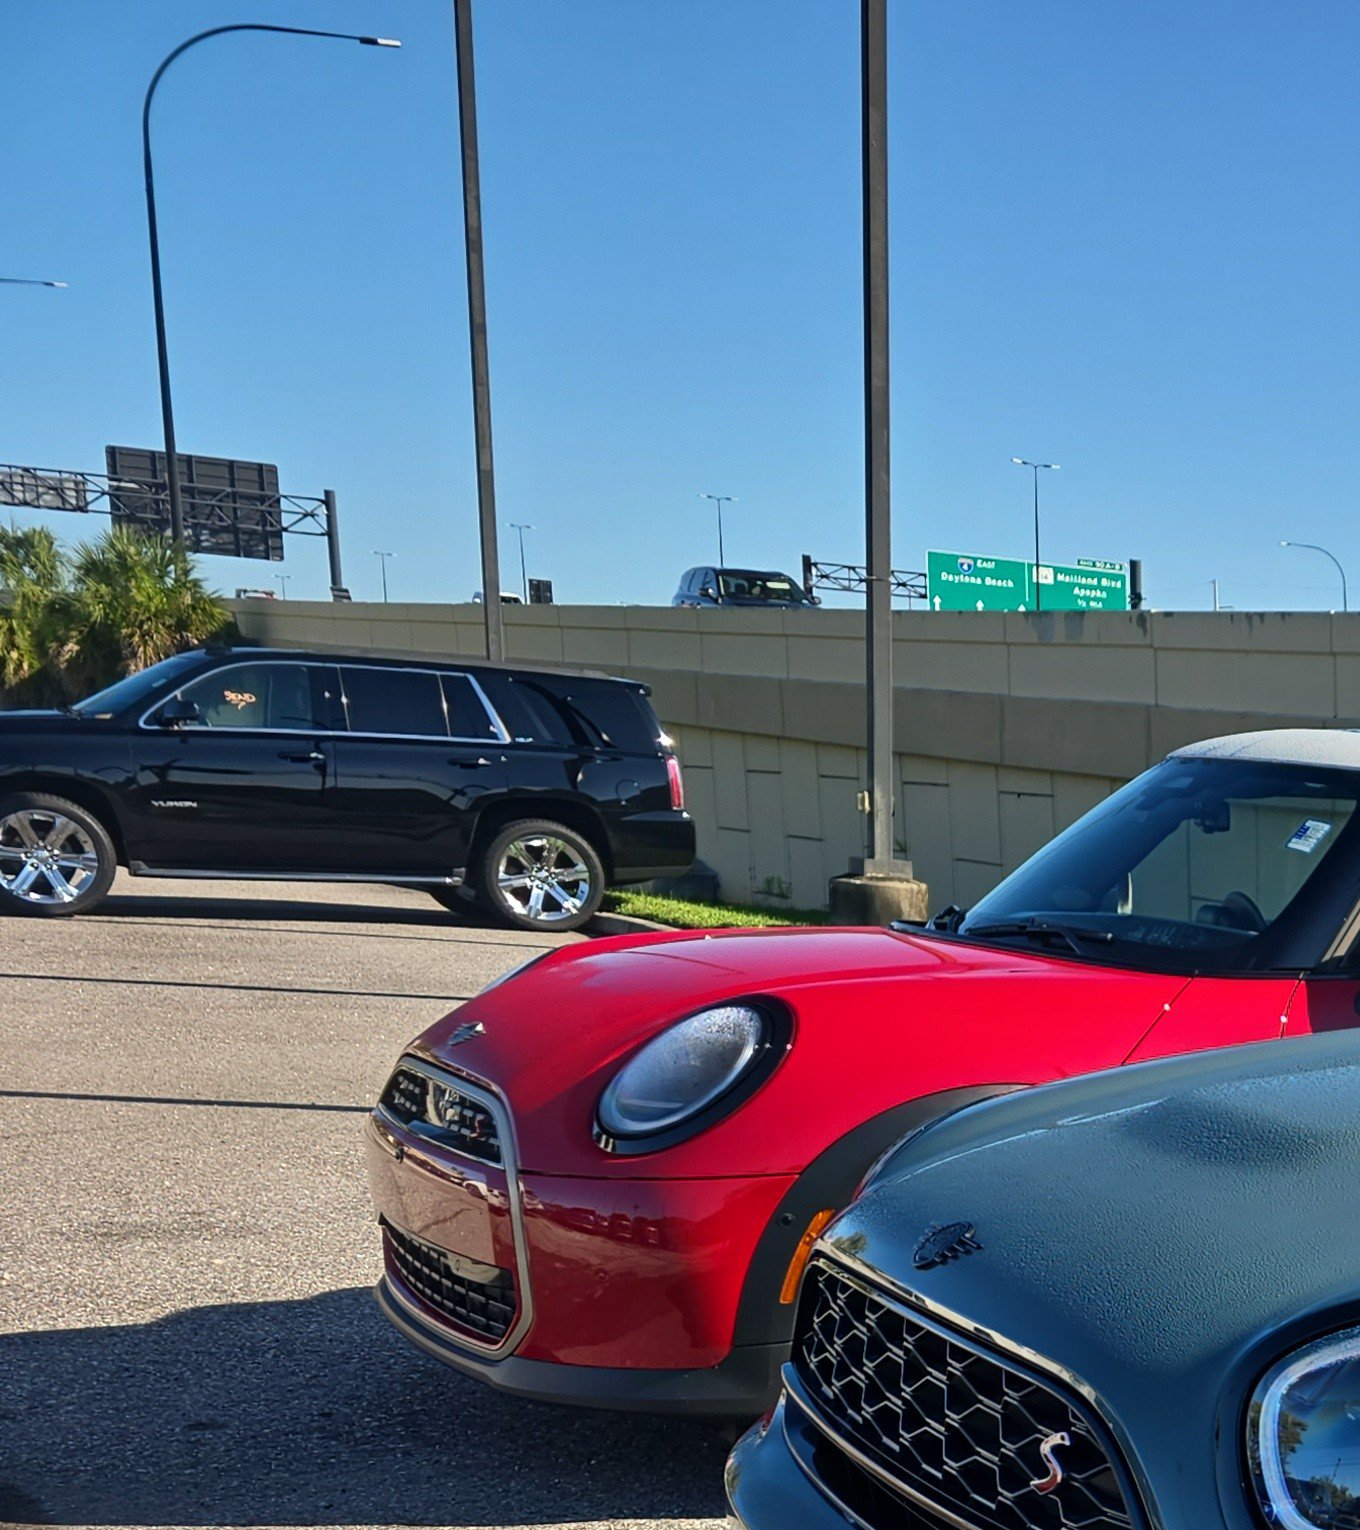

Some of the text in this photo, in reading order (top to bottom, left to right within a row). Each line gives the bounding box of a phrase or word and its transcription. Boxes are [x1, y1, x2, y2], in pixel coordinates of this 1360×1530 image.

[941, 571, 1014, 588] Daytona Beach
[151, 800, 198, 808] YUKON
[1030, 1431, 1070, 1495] S
